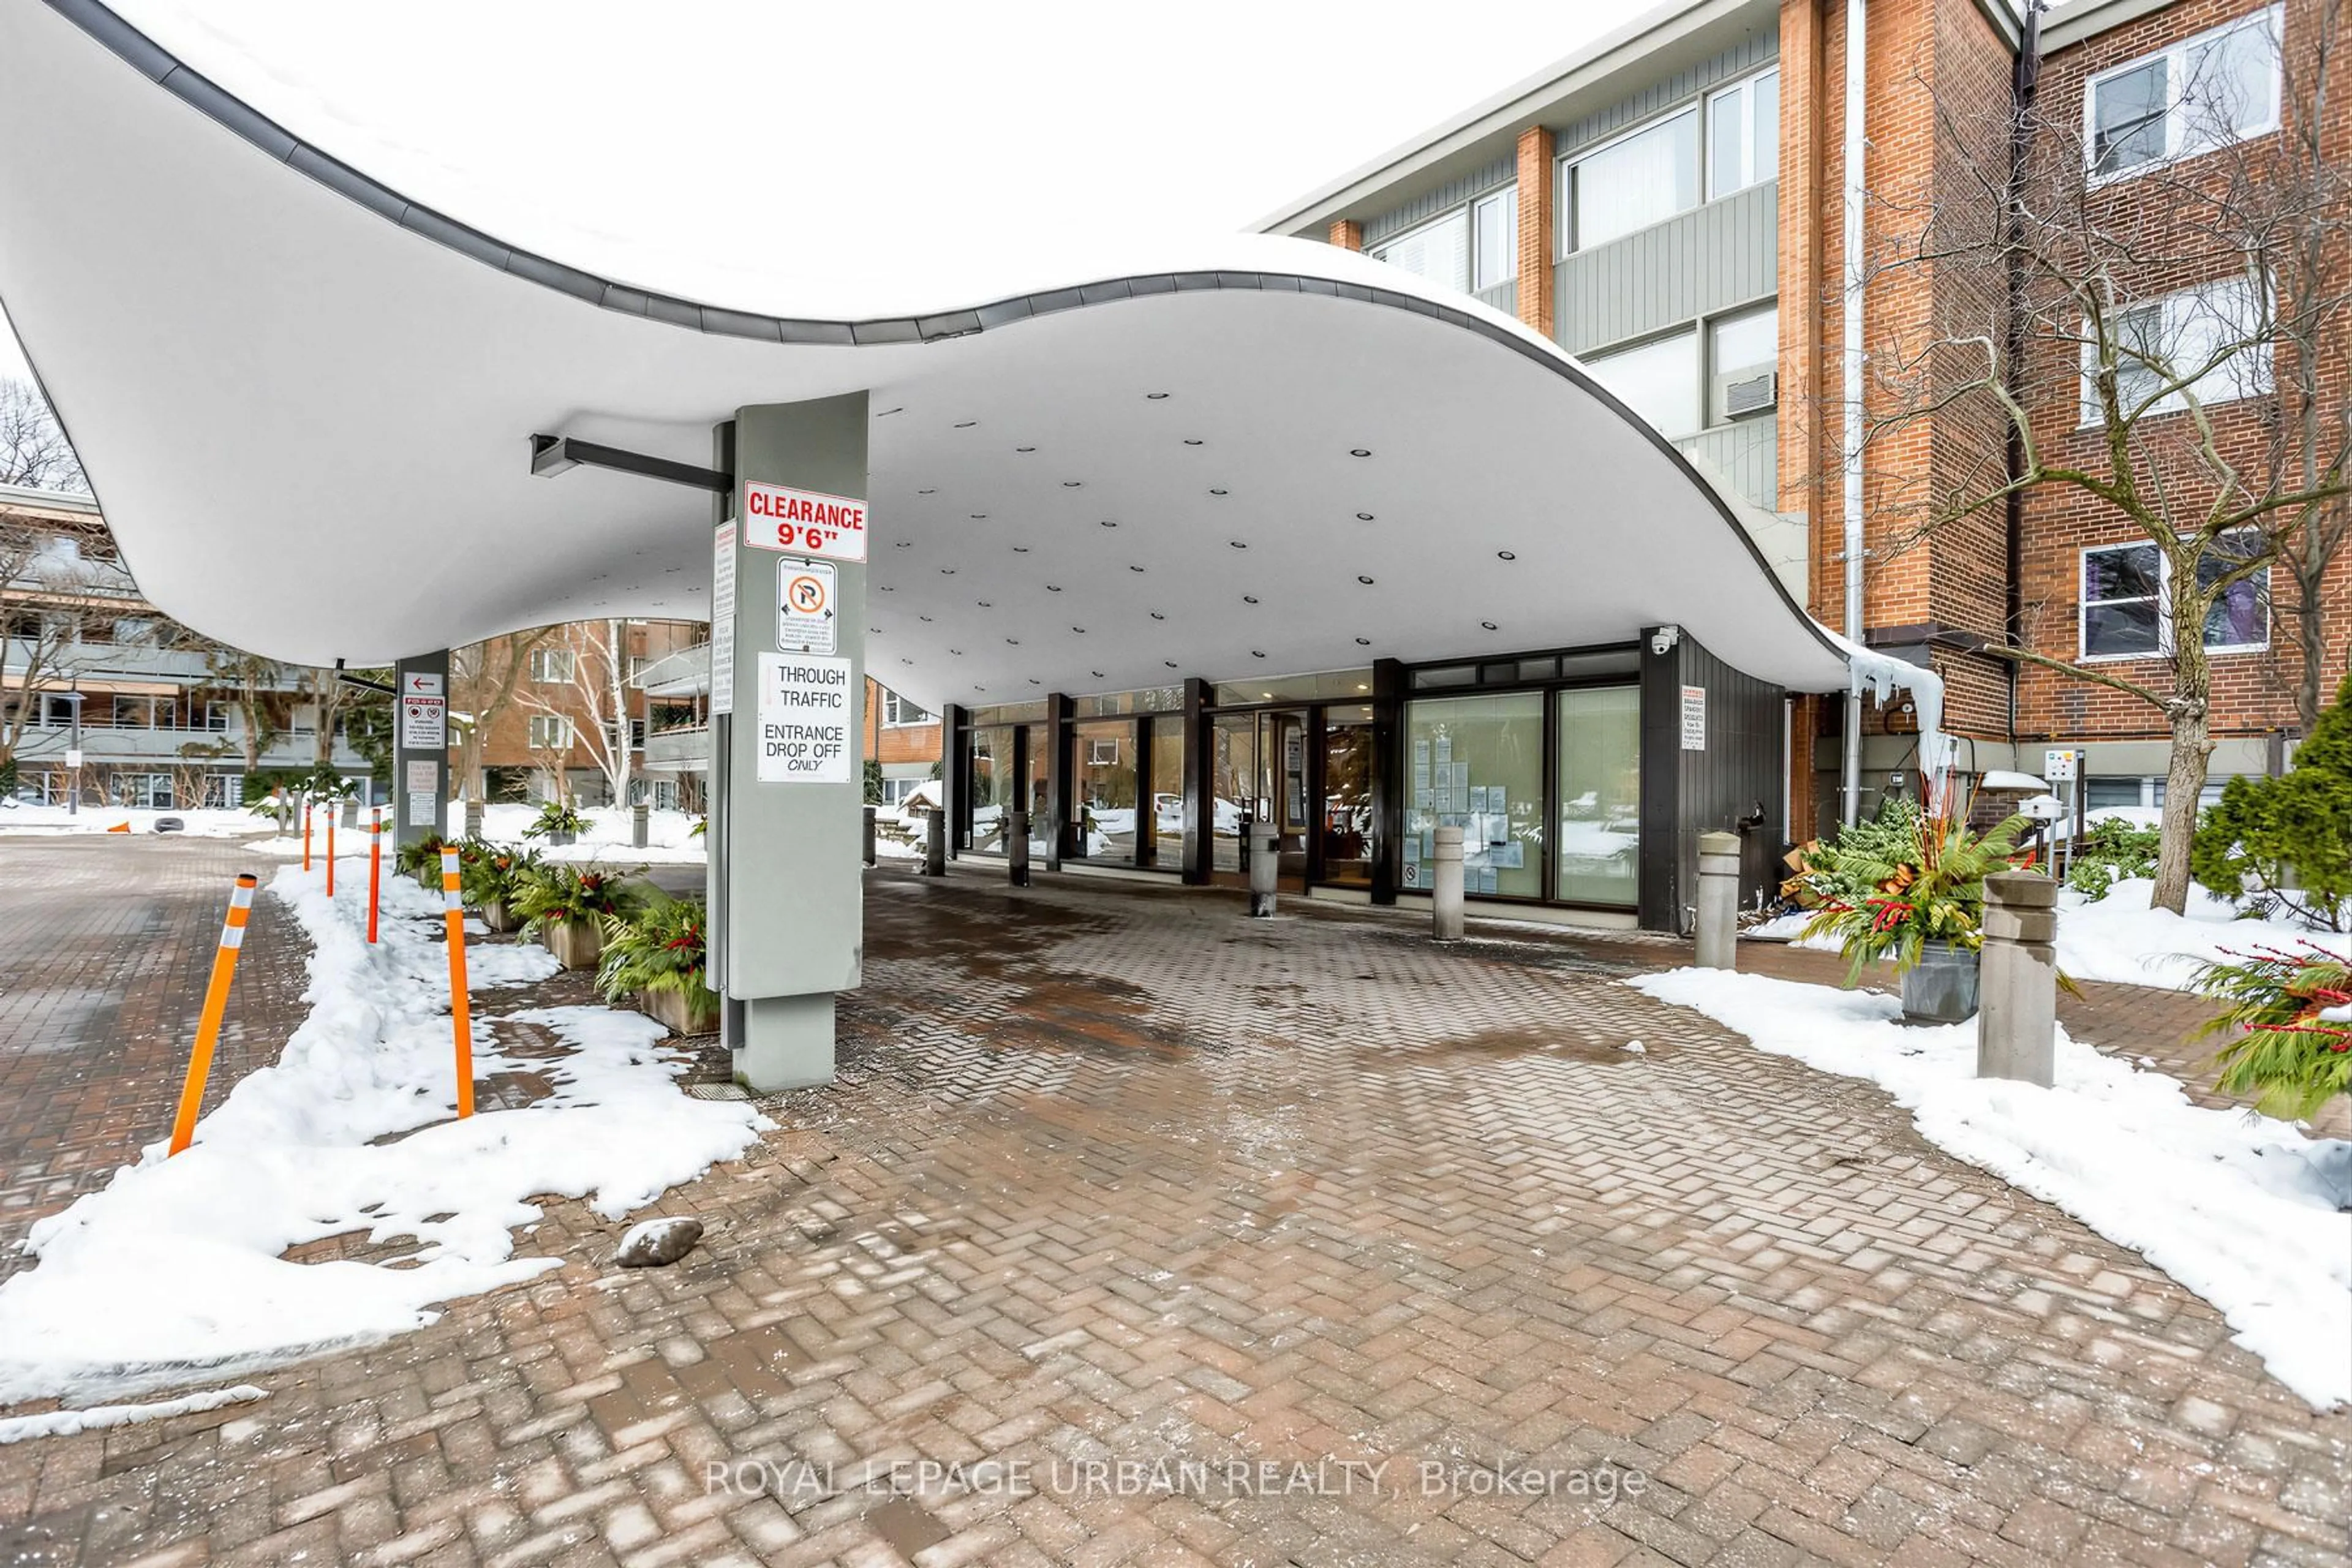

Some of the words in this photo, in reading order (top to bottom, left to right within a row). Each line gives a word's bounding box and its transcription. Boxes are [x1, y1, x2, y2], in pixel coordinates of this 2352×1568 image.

[750, 492, 863, 530] CLEARANCE
[778, 666, 845, 685] THROUGH
[781, 690, 842, 708] TRAFFIC
[765, 724, 843, 741] ENTRANCE
[766, 742, 807, 758] DROP
[813, 743, 841, 758] OFF
